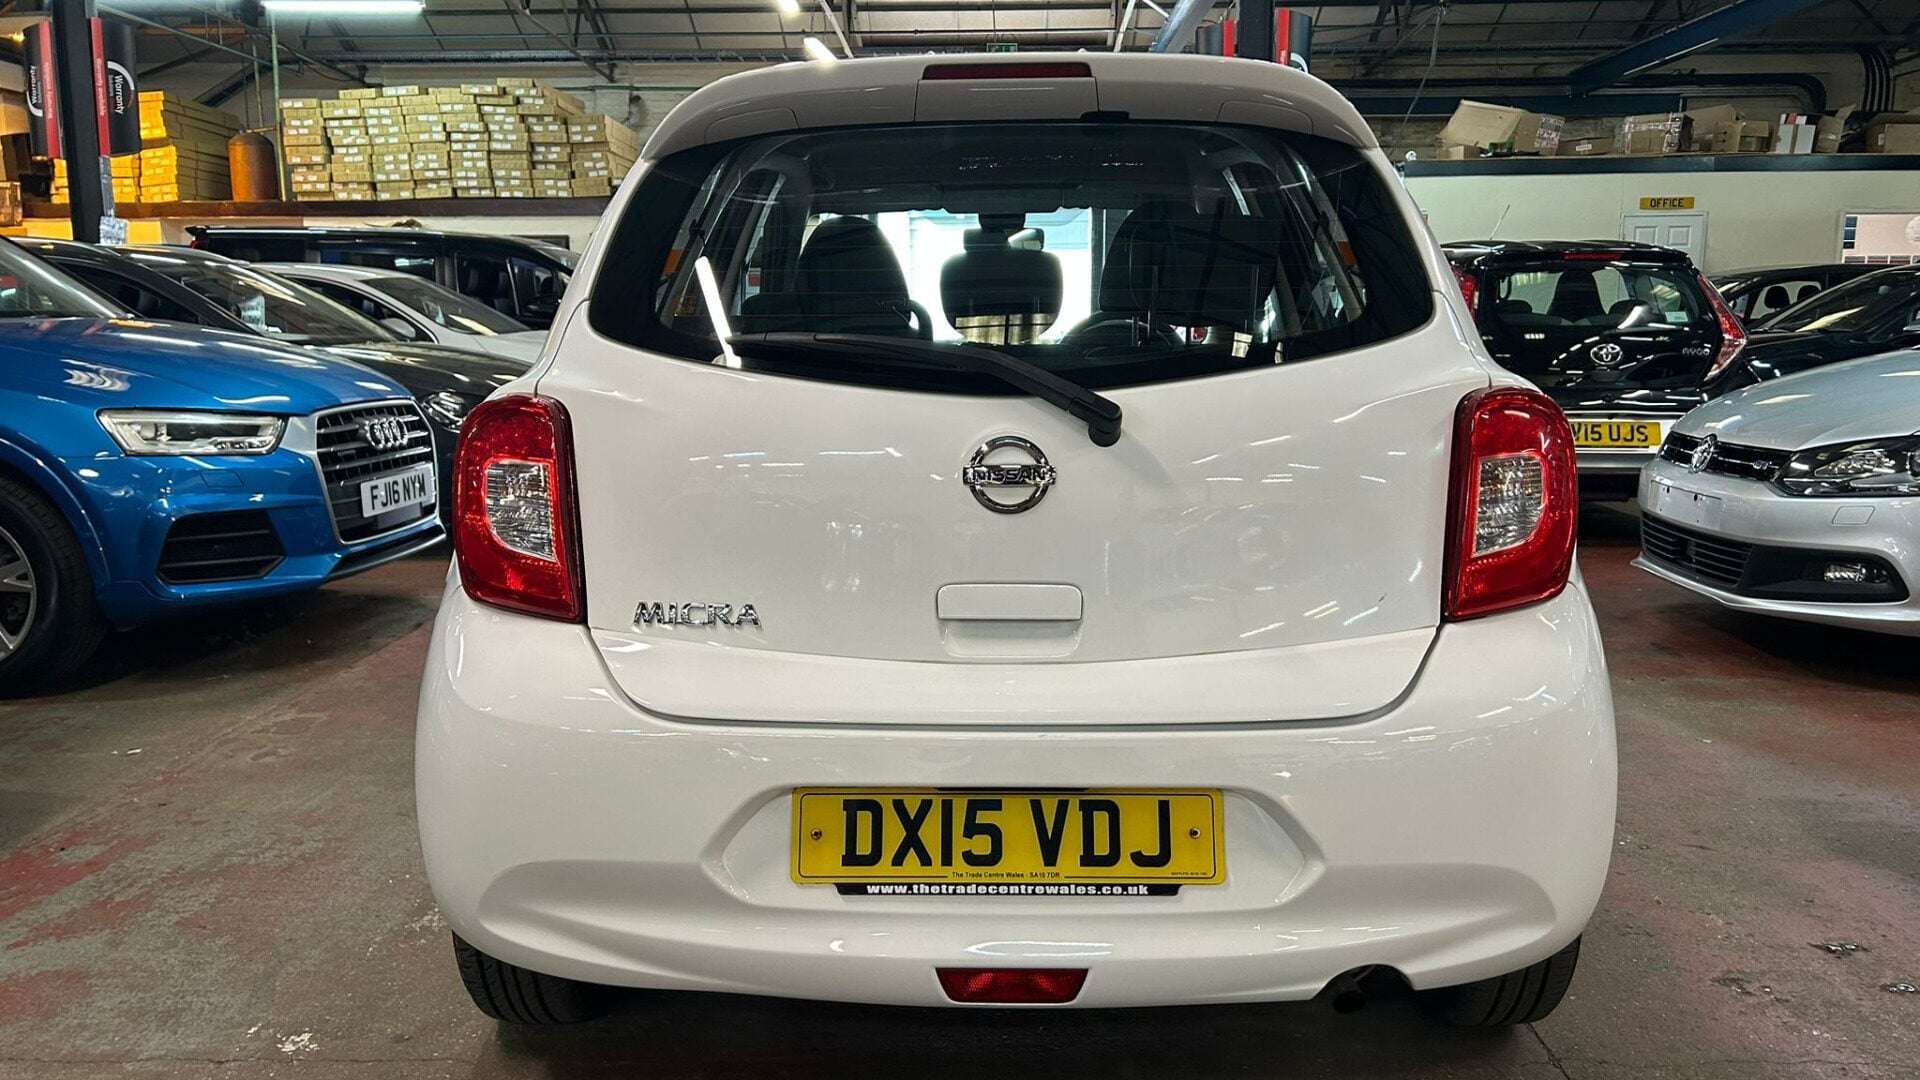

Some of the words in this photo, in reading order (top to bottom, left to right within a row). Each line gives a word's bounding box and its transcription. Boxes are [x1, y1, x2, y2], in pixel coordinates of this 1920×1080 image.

[29, 65, 38, 105] Warranty
[114, 75, 125, 115] Warranty
[1650, 198, 1684, 208] OFFICE
[1608, 423, 1649, 442] UJS
[972, 468, 1047, 482] NISSAN
[370, 480, 400, 511] FJ16
[633, 601, 761, 626] MICRA
[841, 799, 1003, 868] DX15
[1029, 799, 1172, 868] VDJ
[866, 884, 1149, 895] www.thetradecentrewales.co.uk
